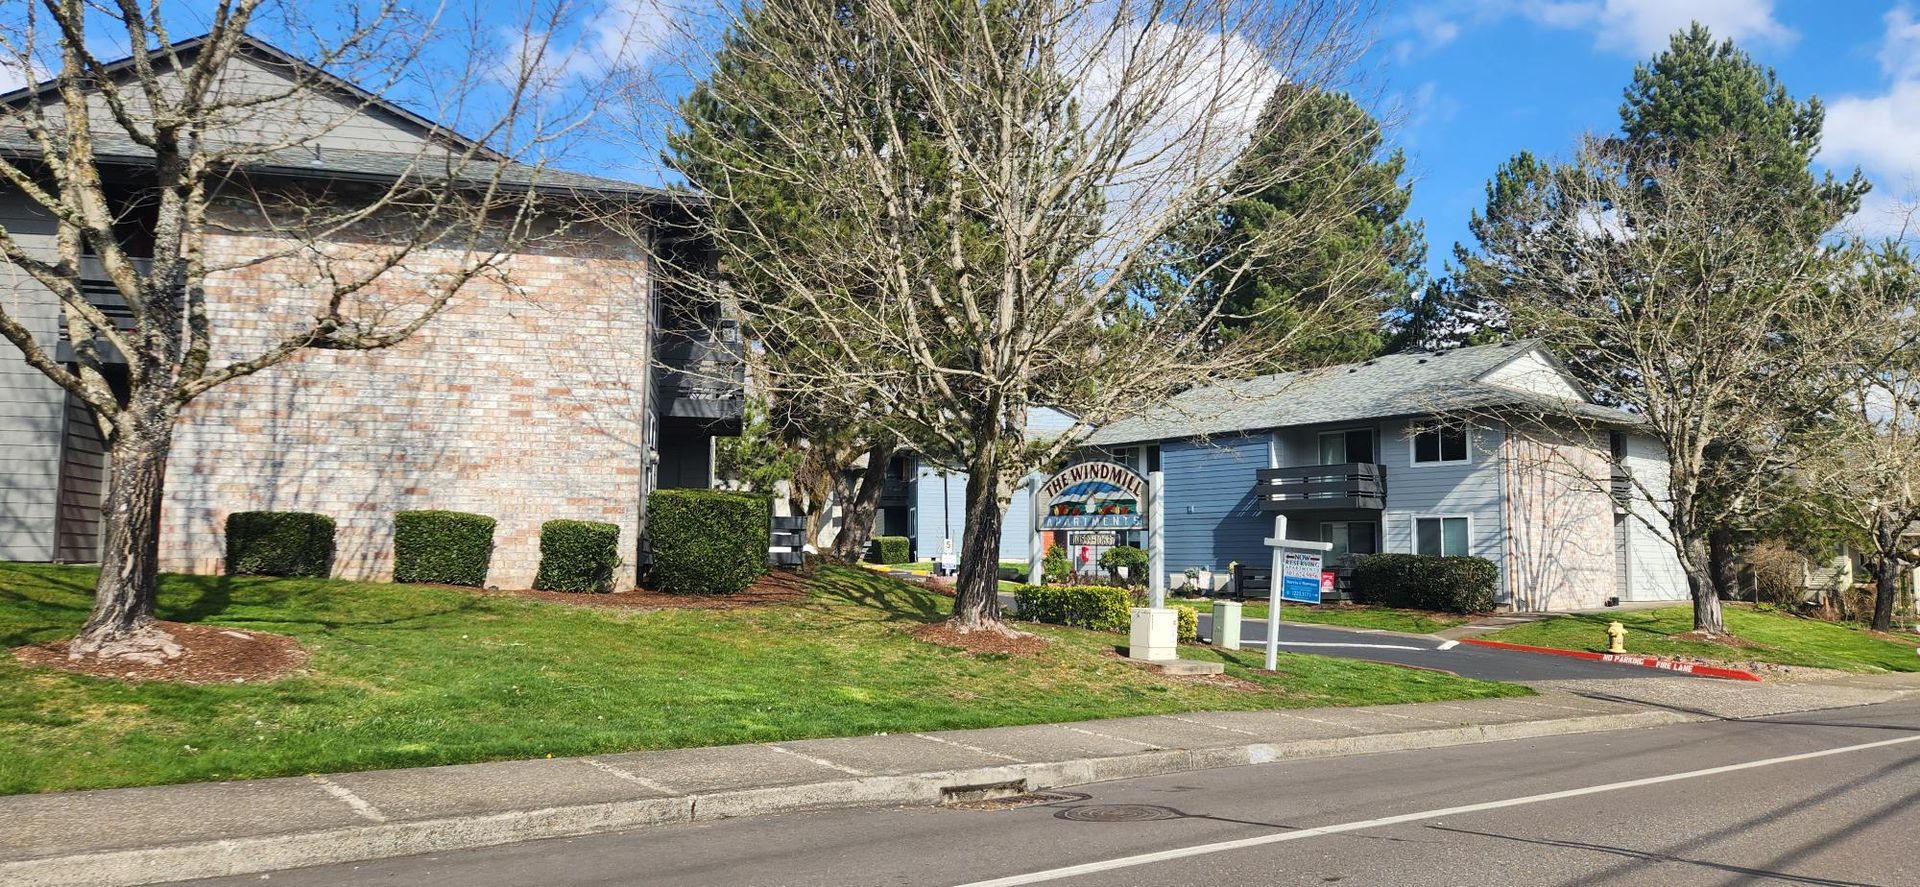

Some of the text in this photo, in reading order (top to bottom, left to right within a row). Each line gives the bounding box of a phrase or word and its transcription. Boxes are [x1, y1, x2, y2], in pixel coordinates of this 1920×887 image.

[1045, 464, 1144, 498] THE WINDMILL
[1046, 516, 1140, 527] APARTMENTS
[1286, 560, 1320, 568] RESERVING
[1614, 655, 1644, 665] PARKING
[1655, 661, 1672, 669] FIRE
[1673, 663, 1694, 673] LANE
